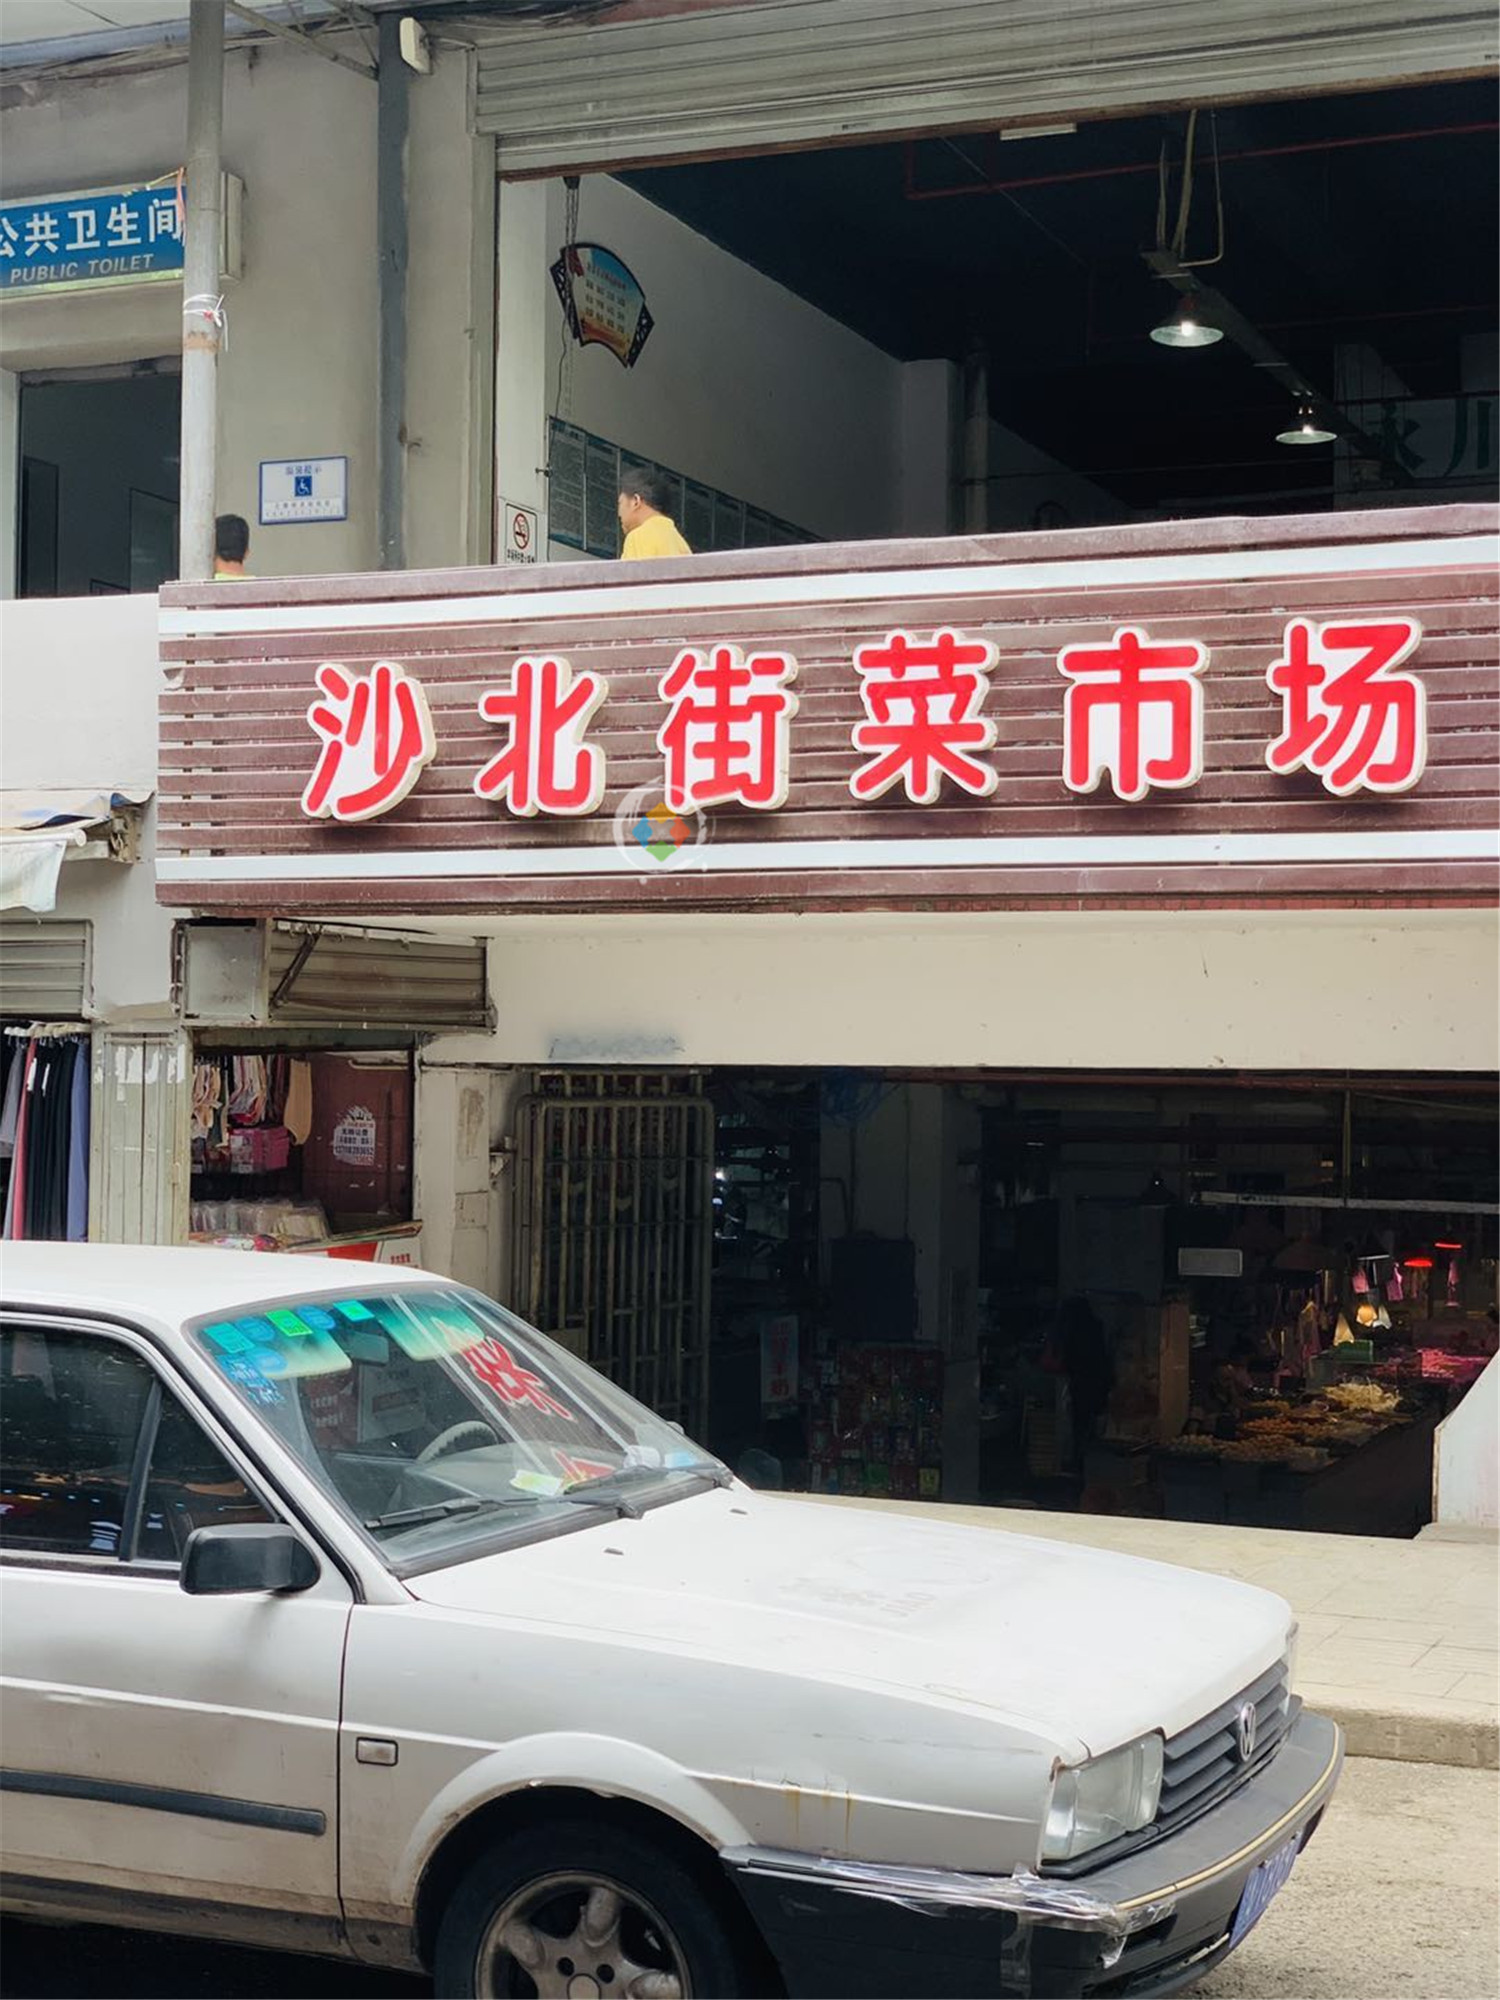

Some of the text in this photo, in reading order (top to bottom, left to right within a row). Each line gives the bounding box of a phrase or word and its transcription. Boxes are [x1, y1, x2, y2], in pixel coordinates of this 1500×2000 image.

[0, 198, 185, 258] 公共卫生间
[10, 253, 155, 284] PUBLIC TOILET
[303, 614, 1424, 819] 沙北街菜市场
